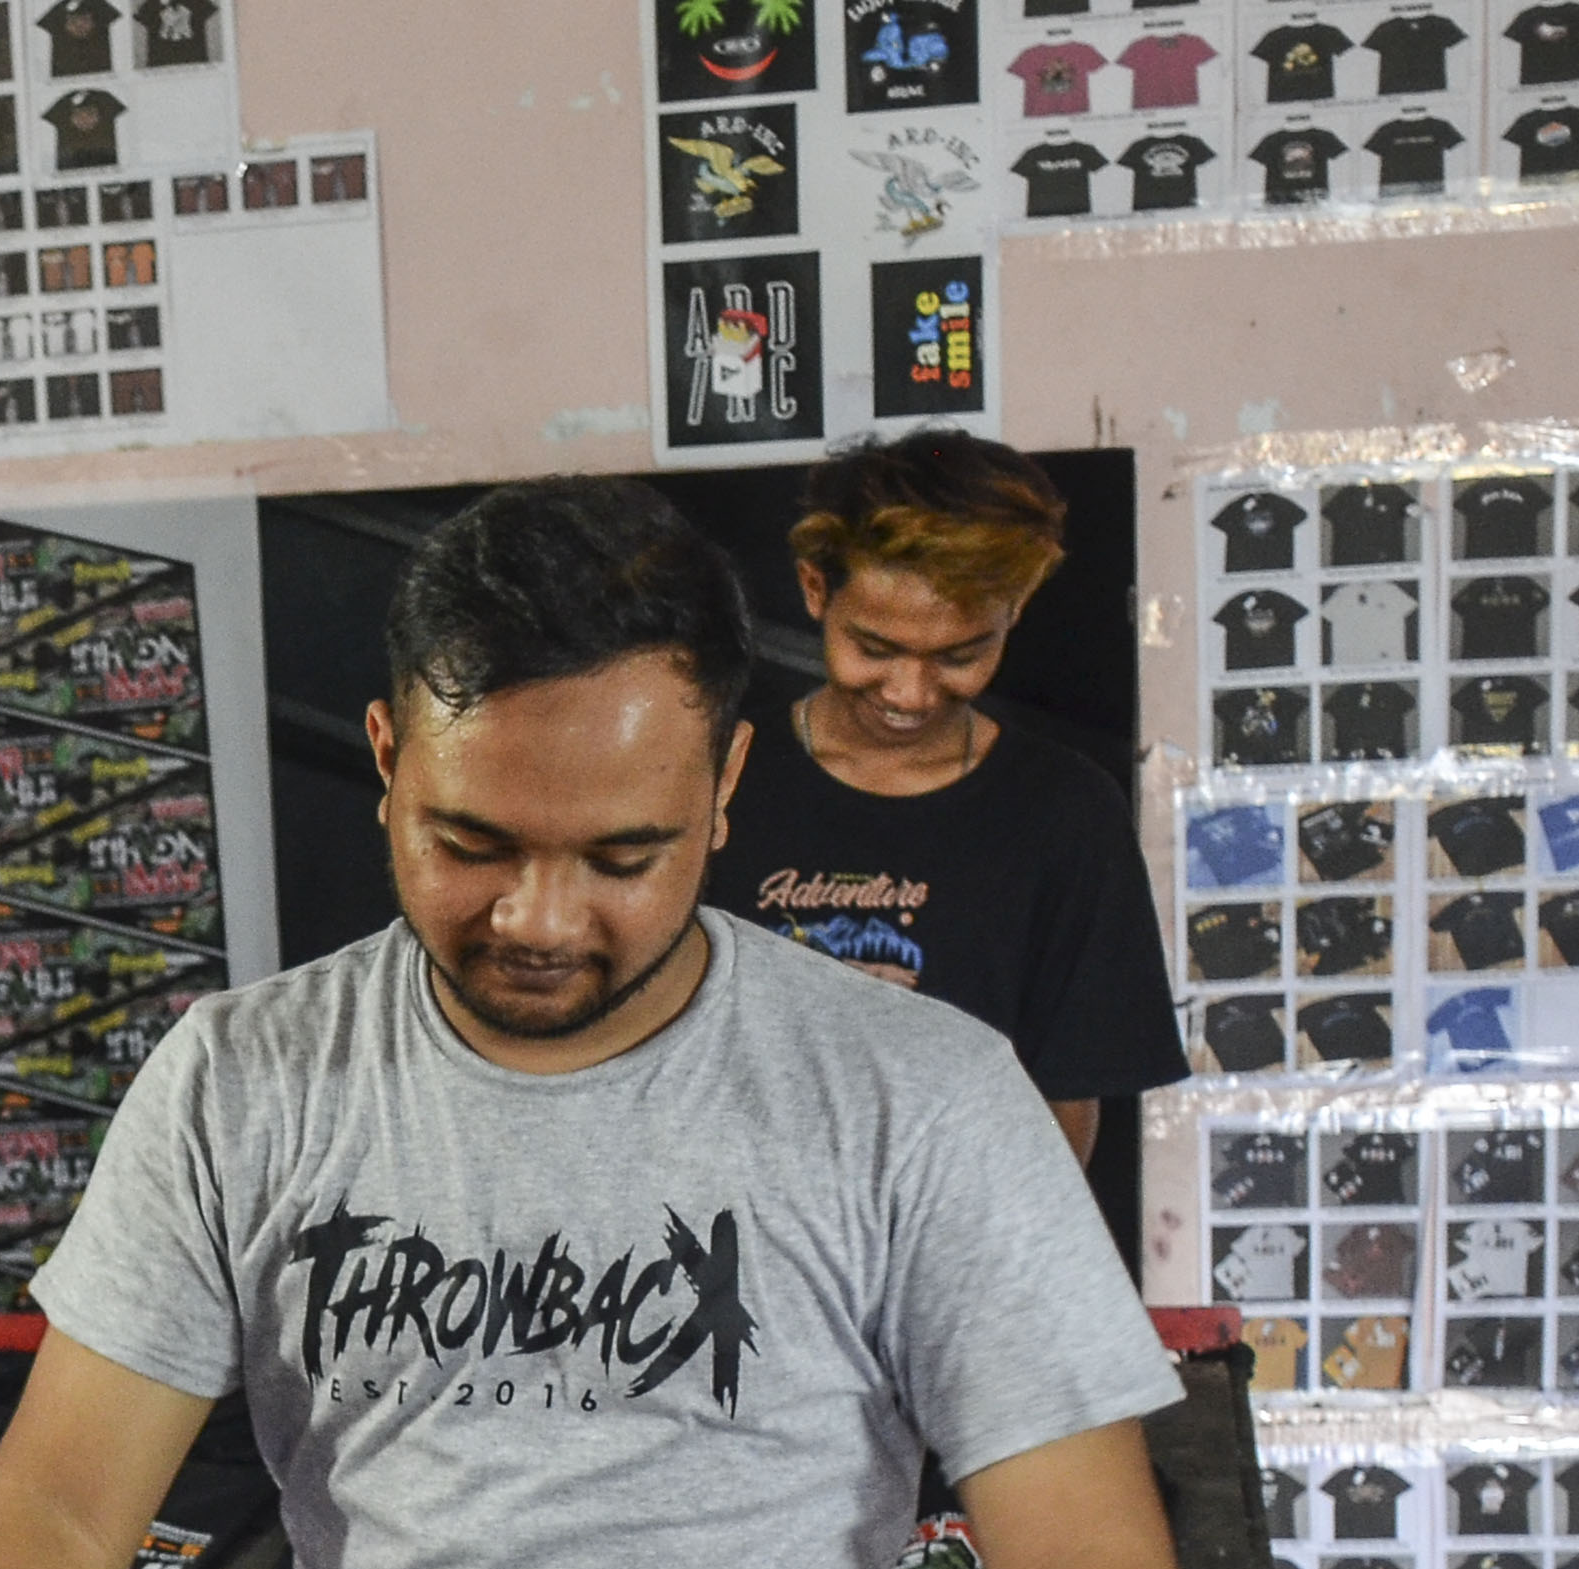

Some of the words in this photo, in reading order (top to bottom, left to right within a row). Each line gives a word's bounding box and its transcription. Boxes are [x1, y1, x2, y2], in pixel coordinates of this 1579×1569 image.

[940, 280, 972, 389] smile
[286, 1198, 760, 1421] THROWBACK
[453, 1380, 600, 1413] 2016
